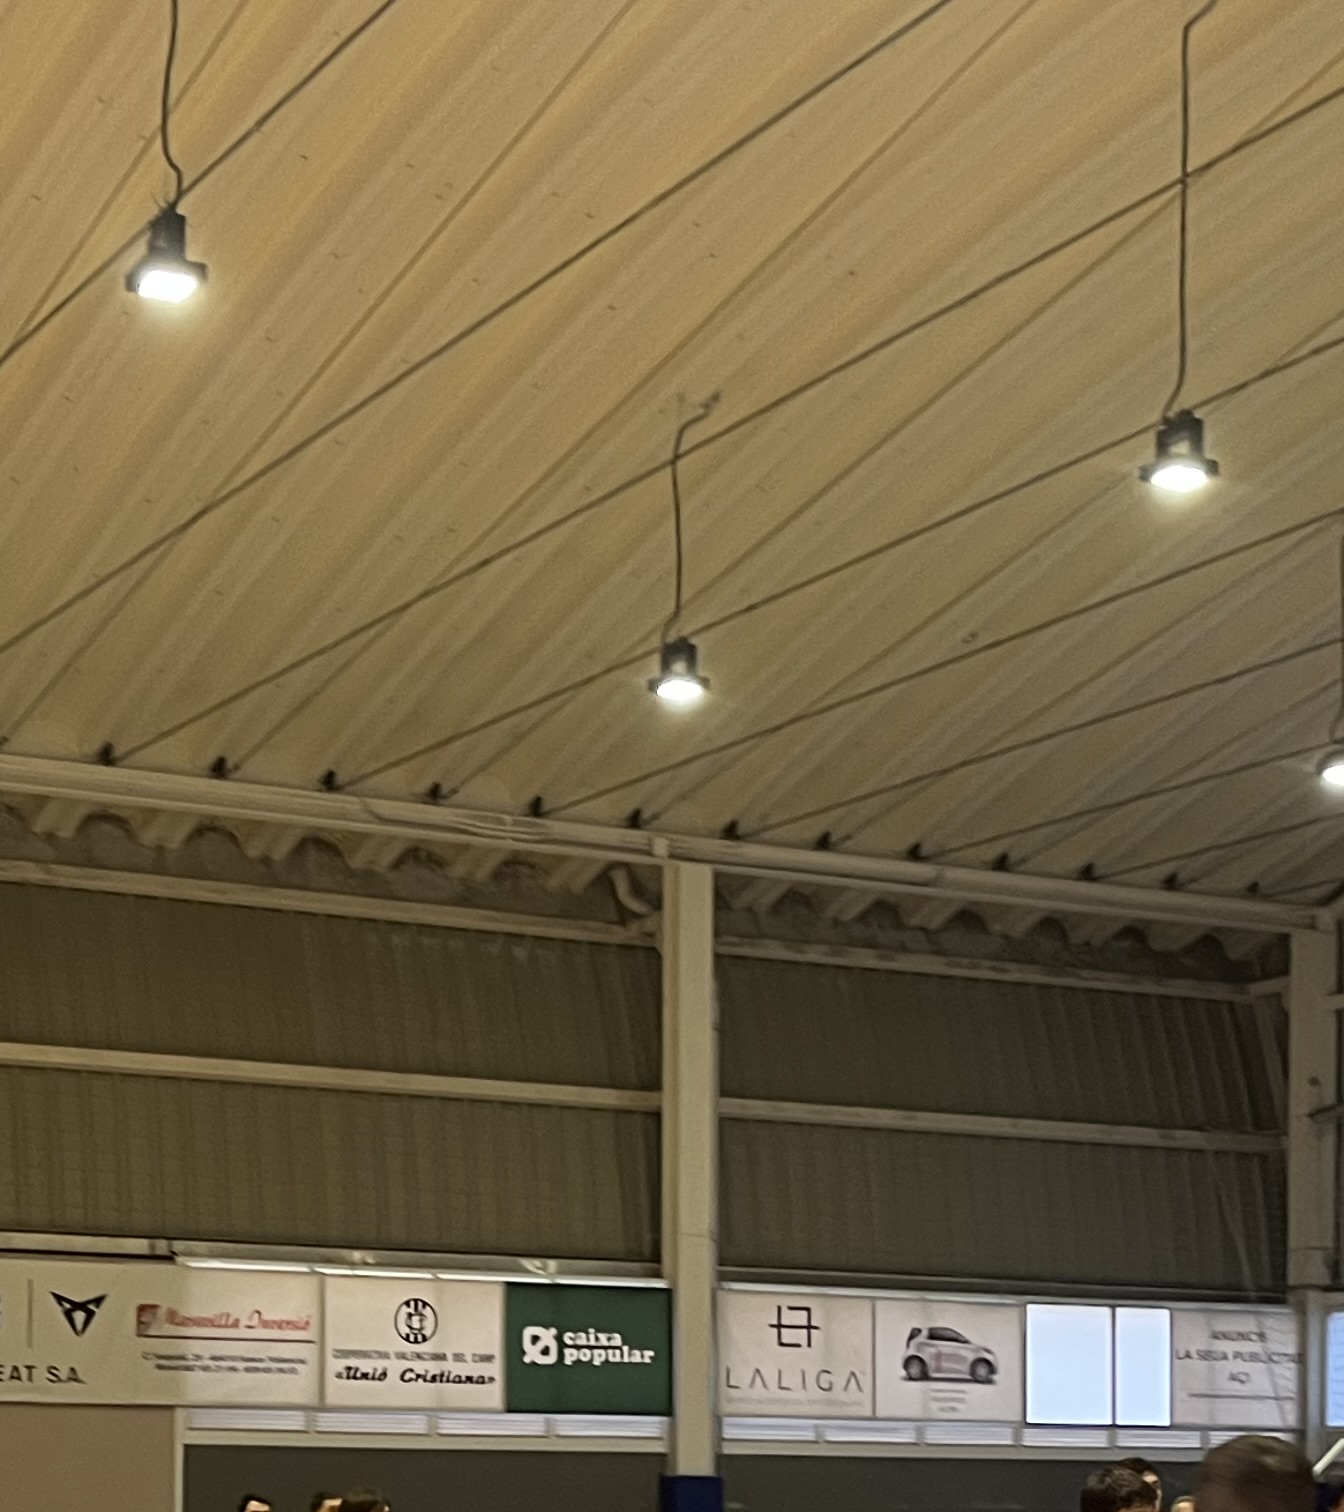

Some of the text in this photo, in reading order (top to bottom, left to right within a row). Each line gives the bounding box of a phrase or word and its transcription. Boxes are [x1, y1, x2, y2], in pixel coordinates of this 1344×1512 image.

[562, 1327, 623, 1347] caixa
[562, 1345, 655, 1366] popular
[726, 1366, 865, 1393] LALIGA
